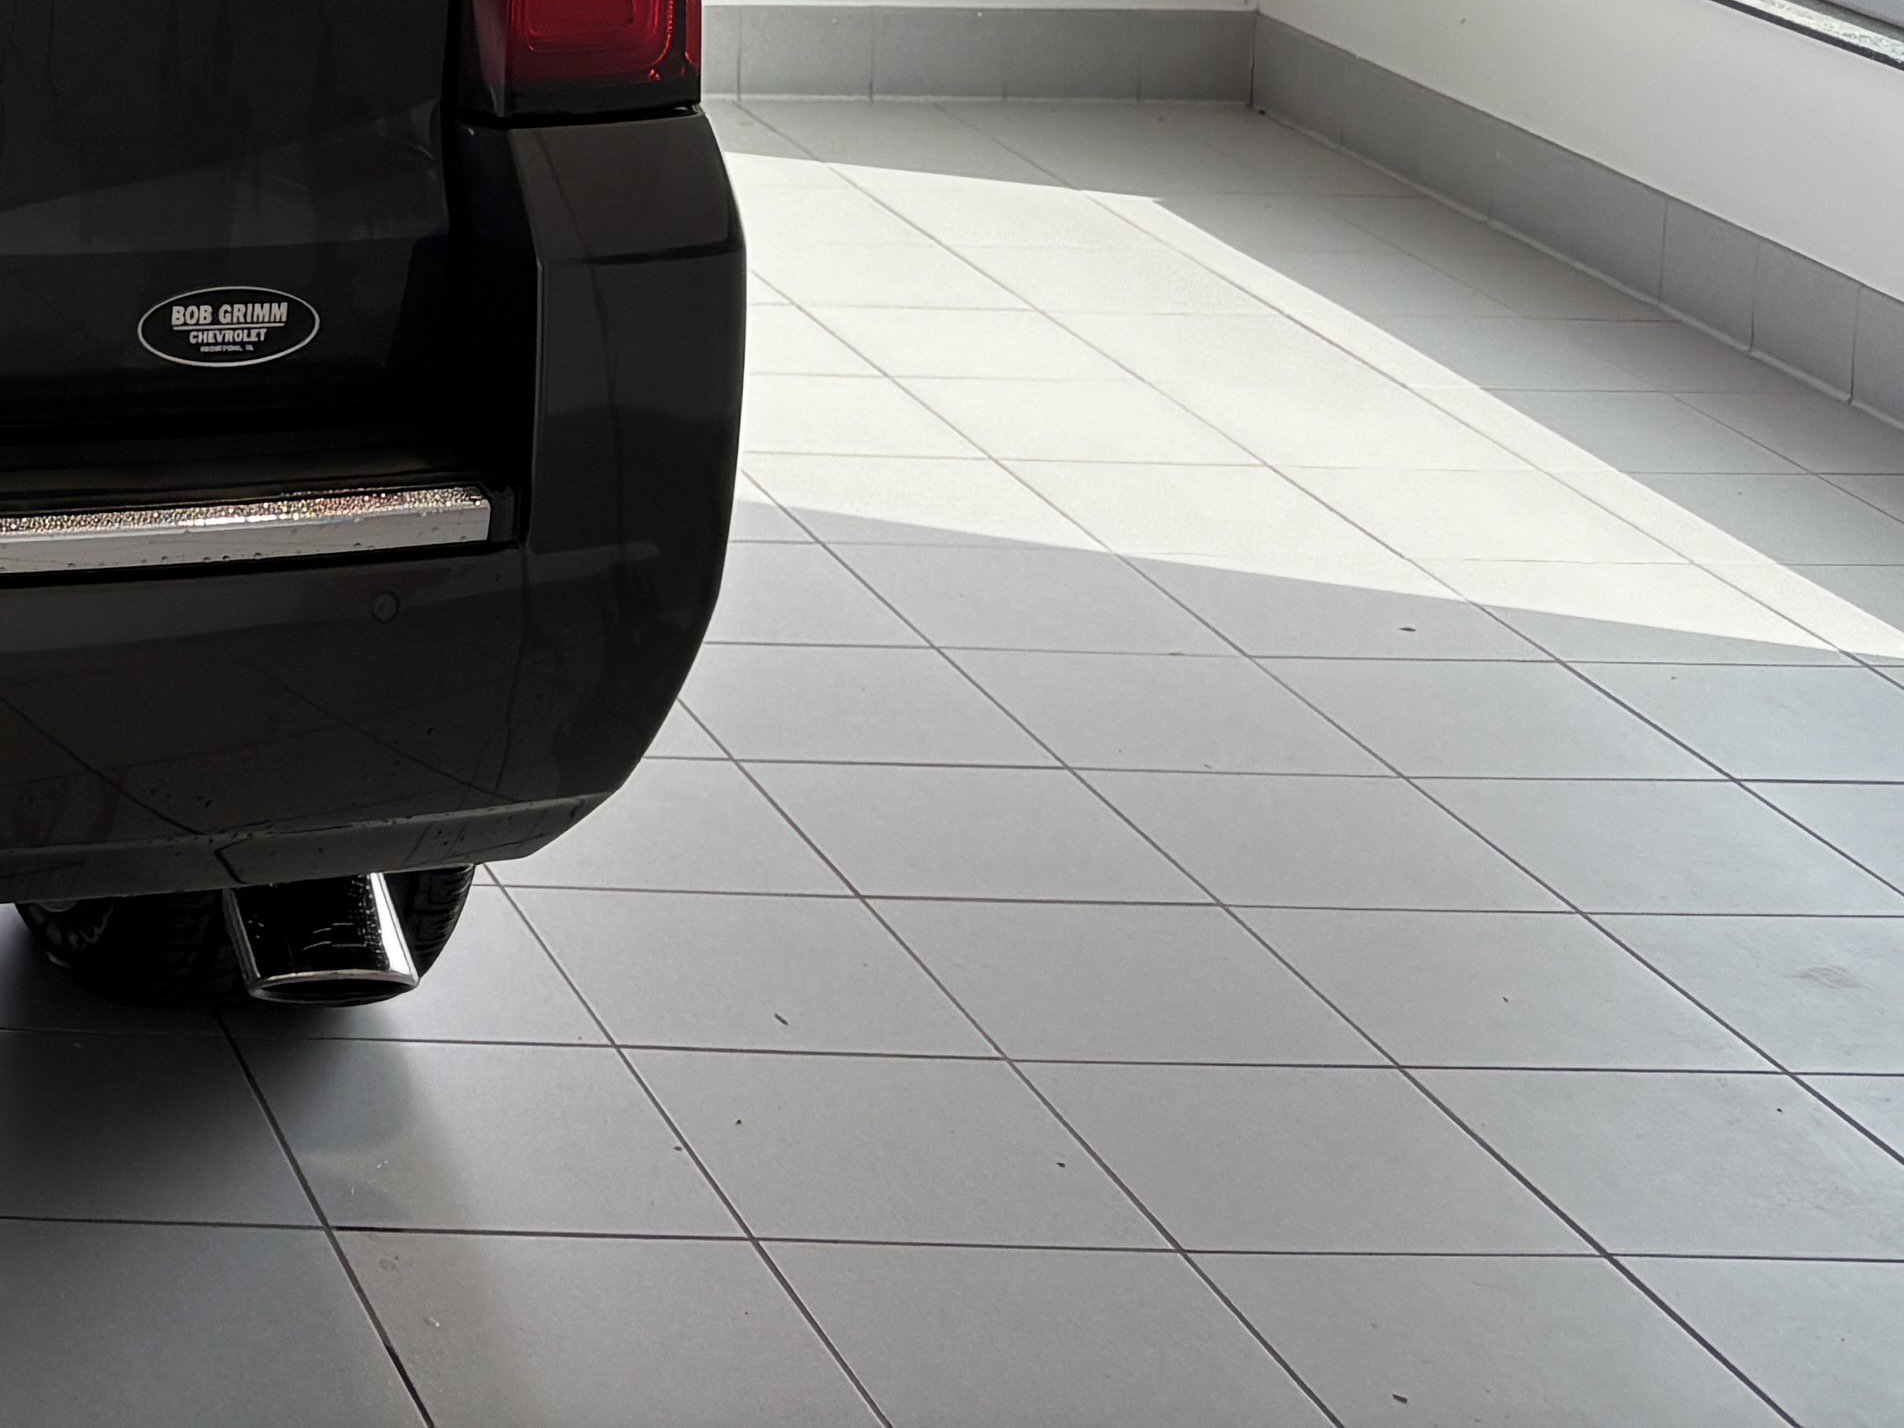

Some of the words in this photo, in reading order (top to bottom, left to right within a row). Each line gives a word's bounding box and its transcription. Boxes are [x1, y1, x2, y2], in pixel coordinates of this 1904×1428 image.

[171, 304, 213, 325] BOB
[217, 301, 288, 323] GRIMM
[188, 328, 268, 344] CHEVROLET
